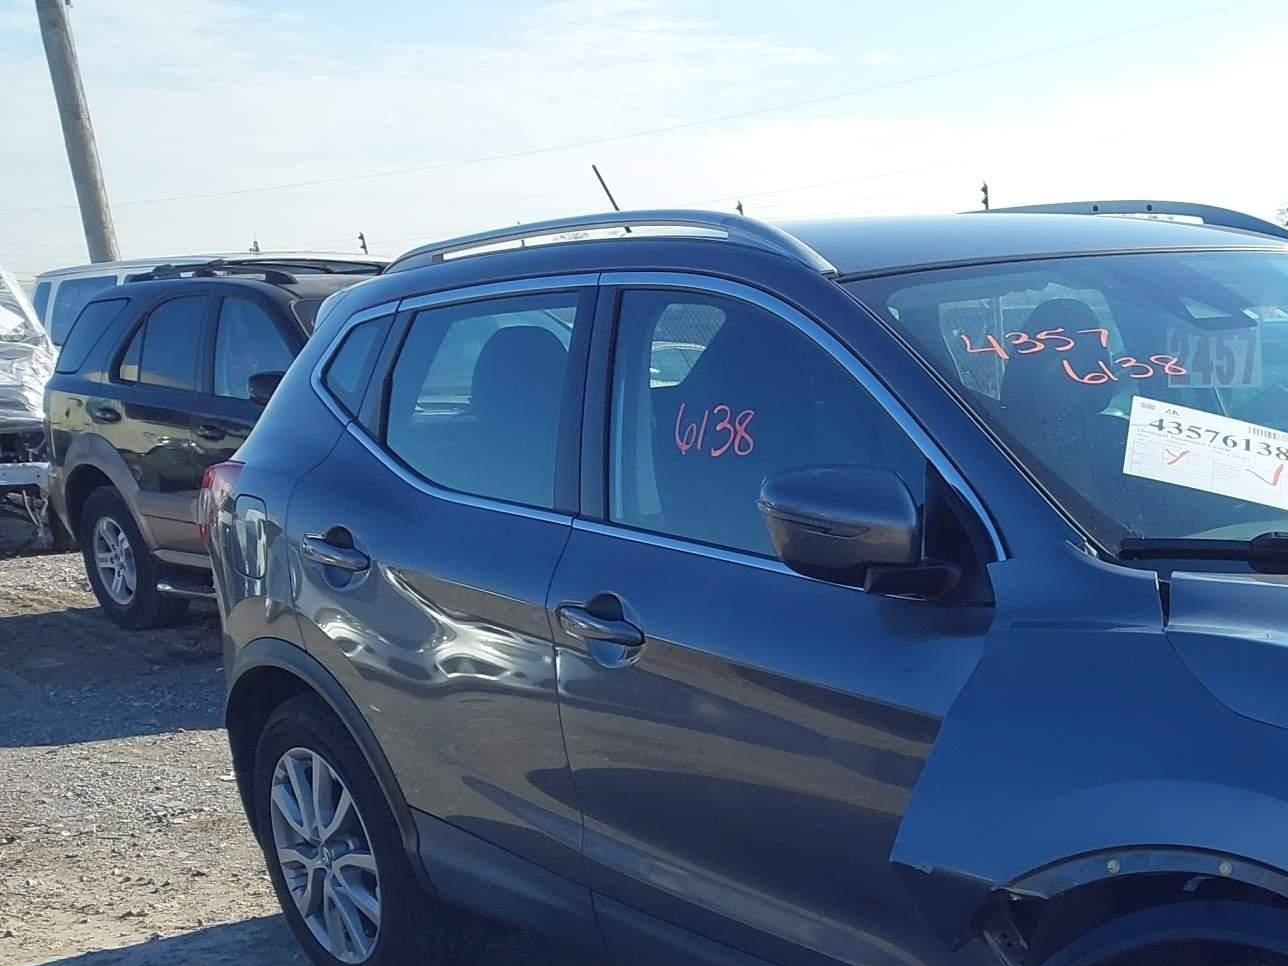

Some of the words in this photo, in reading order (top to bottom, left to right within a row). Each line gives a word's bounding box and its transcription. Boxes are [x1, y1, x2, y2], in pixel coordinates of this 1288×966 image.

[960, 327, 1110, 360] 4357
[1062, 354, 1187, 385] 6138
[674, 402, 756, 457] 6138
